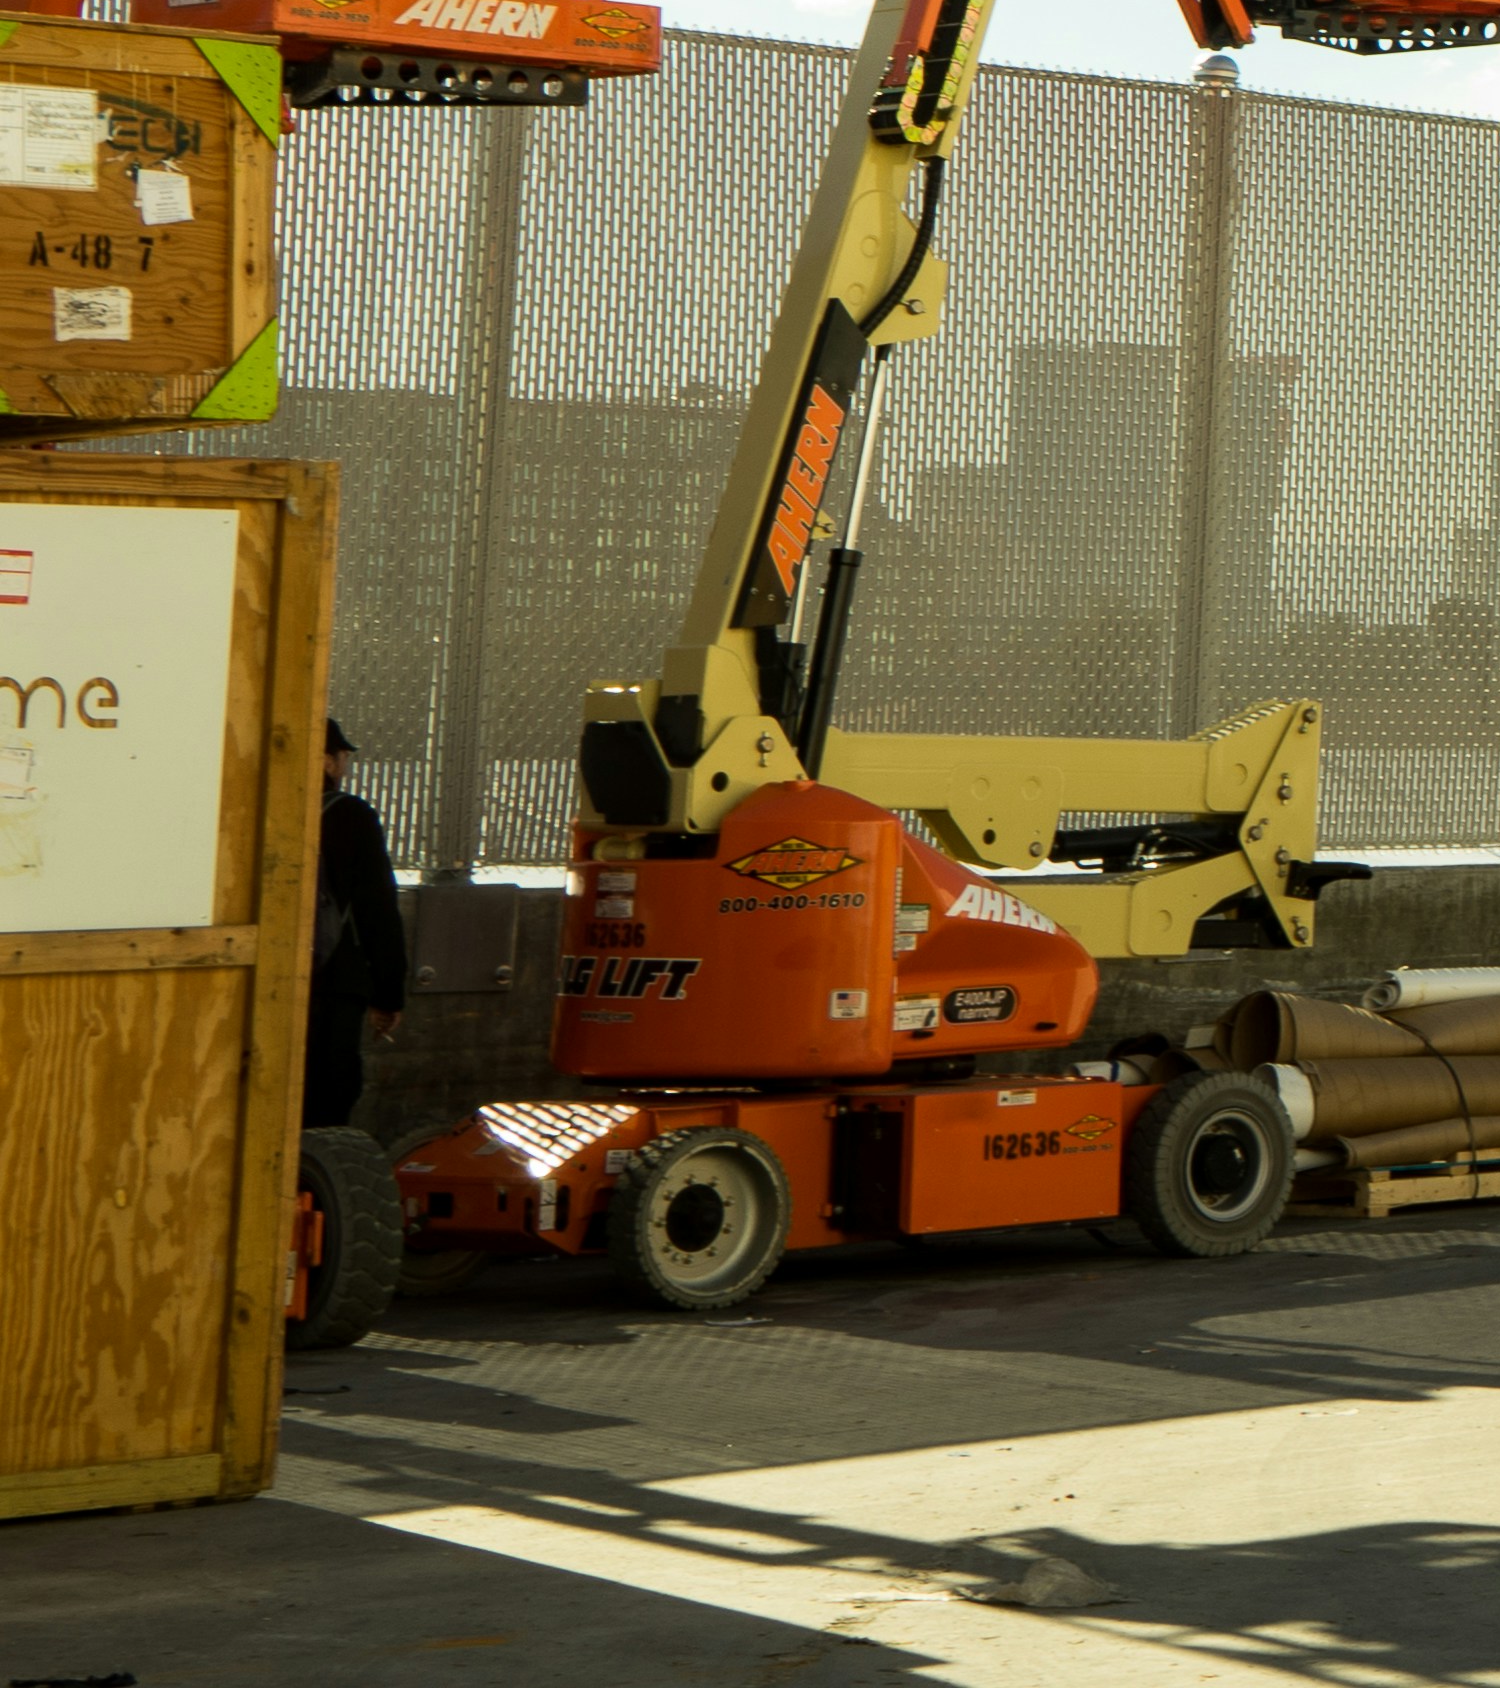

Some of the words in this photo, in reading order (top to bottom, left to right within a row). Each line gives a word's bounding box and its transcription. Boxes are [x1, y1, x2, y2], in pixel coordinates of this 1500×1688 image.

[29, 231, 112, 269] A-48
[138, 237, 154, 271] 7
[766, 383, 846, 598] AHERN
[740, 851, 845, 873] AHERN
[719, 893, 865, 913] 800-400-1610
[955, 990, 1006, 1006] E400AJP
[958, 1006, 1003, 1020] narrow
[983, 1132, 1060, 1160] 162636
